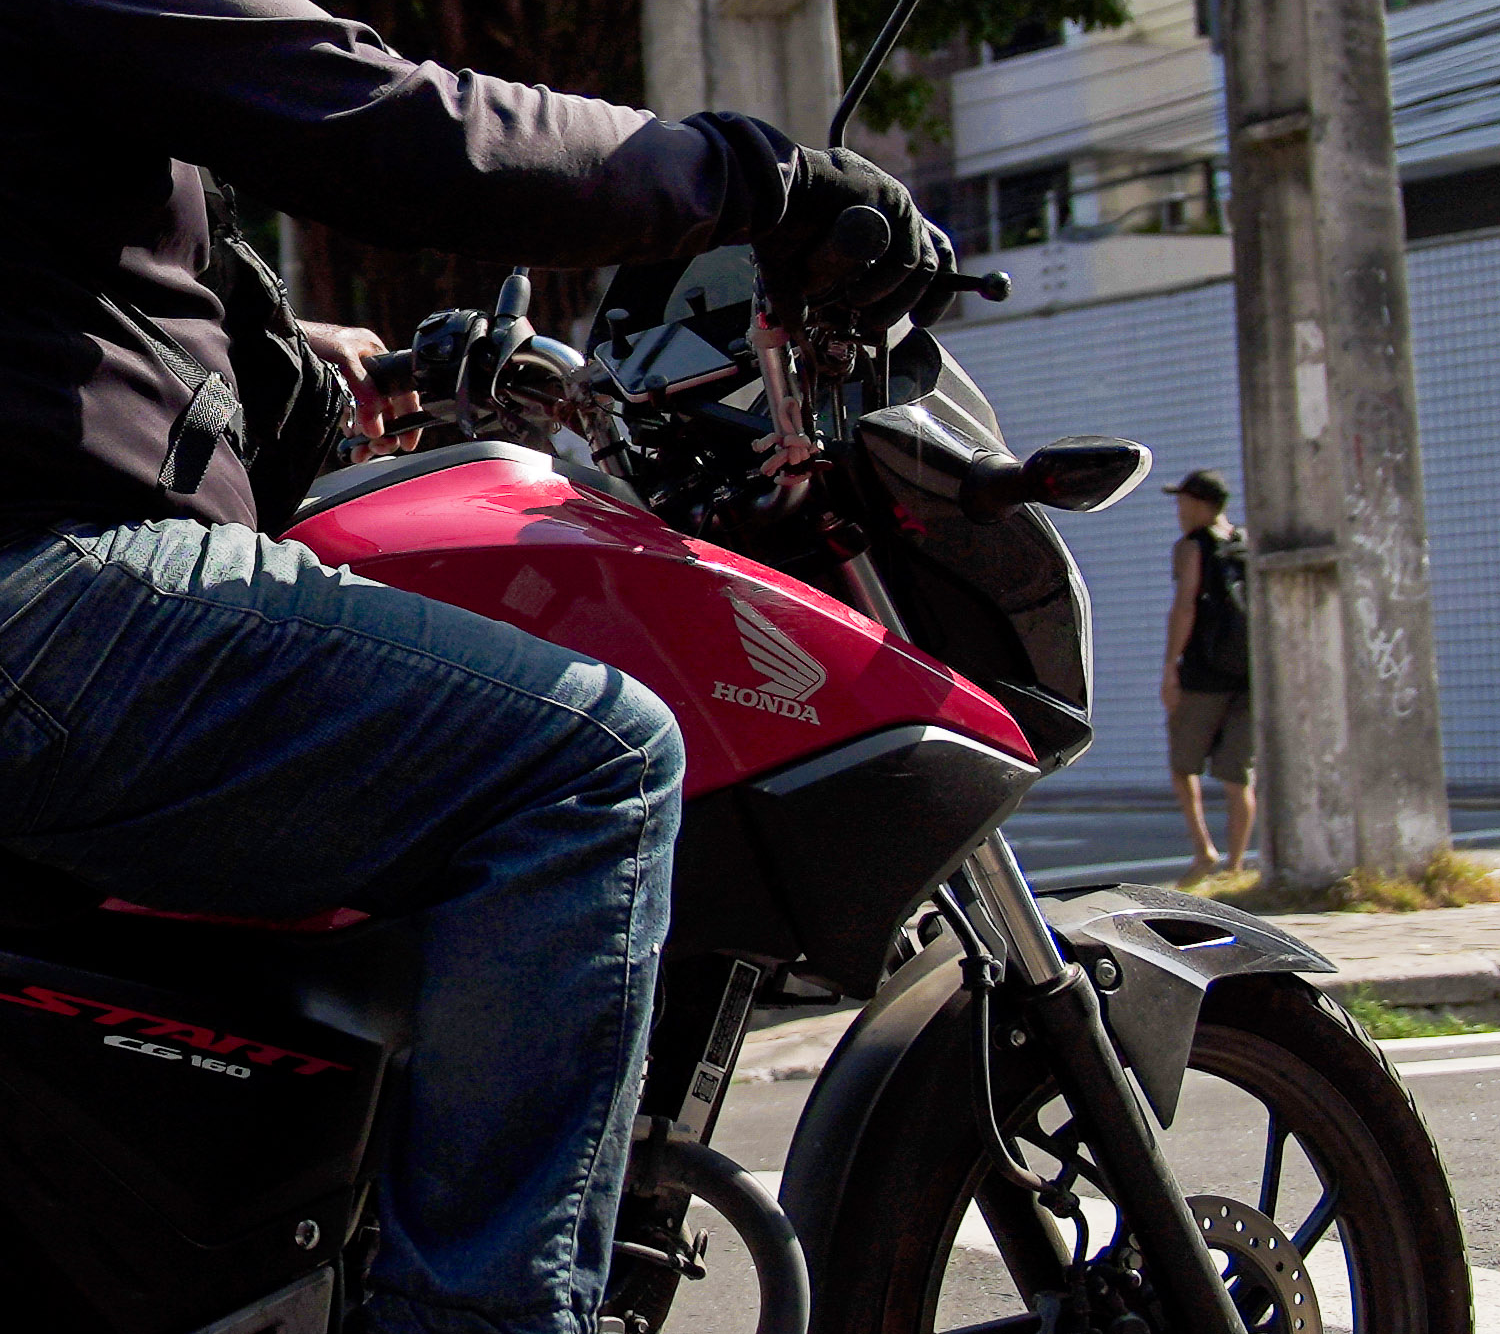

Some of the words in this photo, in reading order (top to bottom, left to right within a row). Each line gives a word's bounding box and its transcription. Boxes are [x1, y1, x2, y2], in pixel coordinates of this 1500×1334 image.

[711, 680, 821, 726] HONDA
[104, 1035, 183, 1060] CG
[190, 1054, 251, 1079] 160
